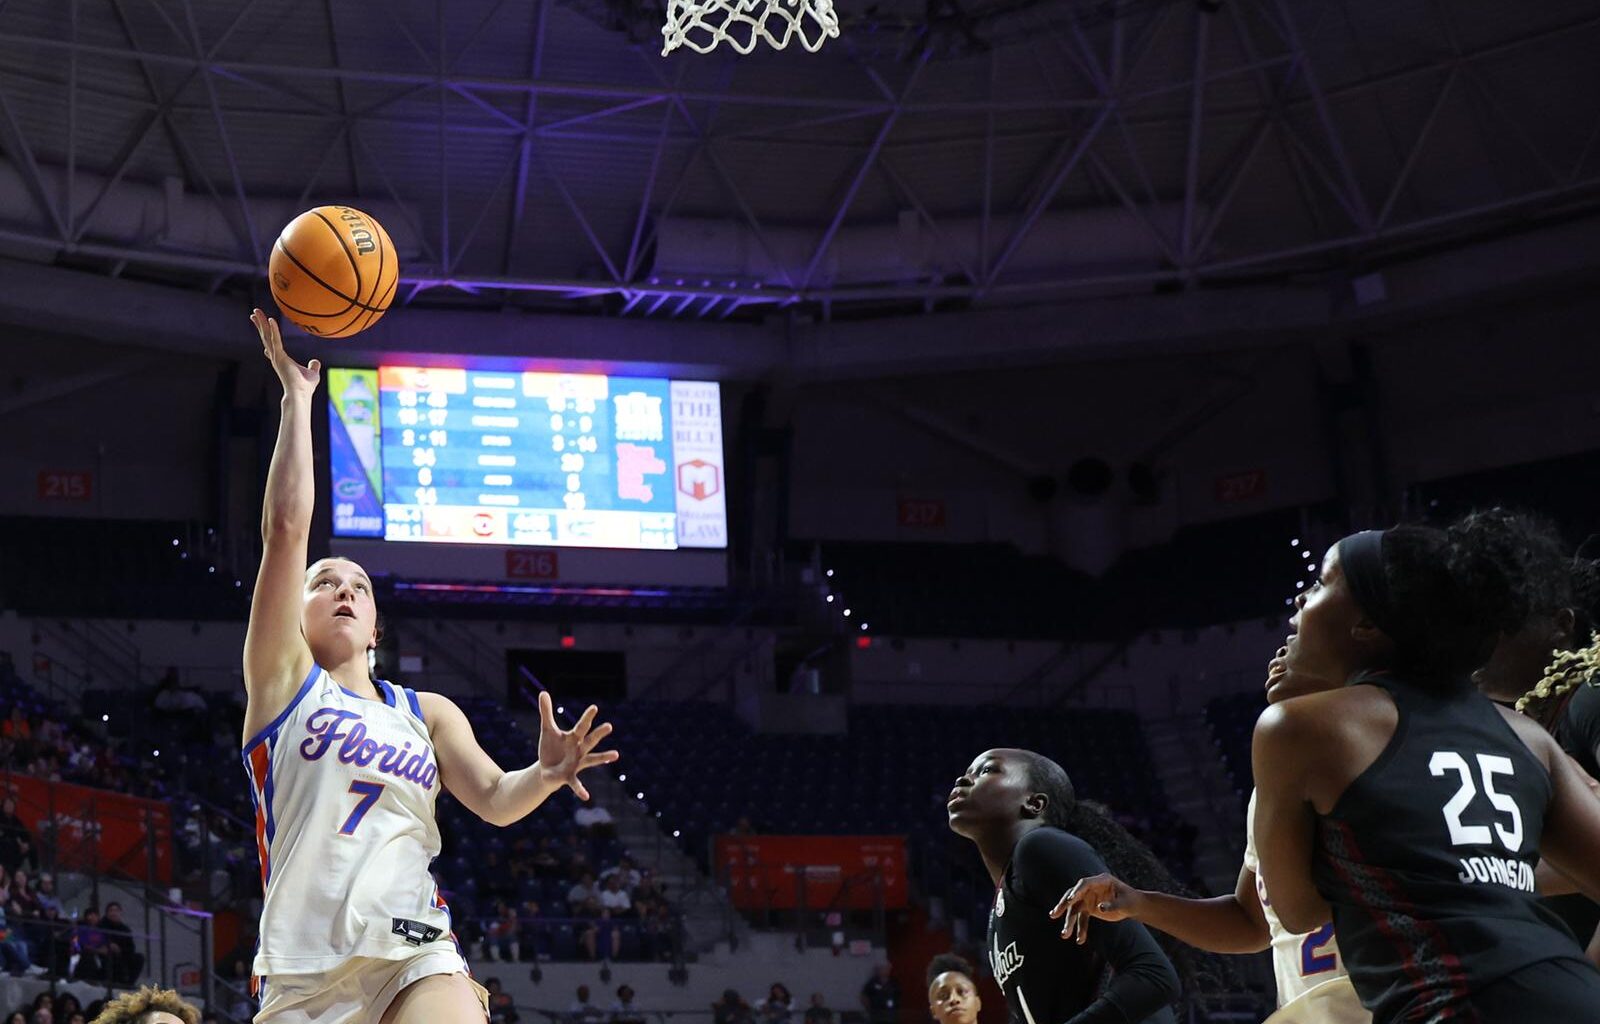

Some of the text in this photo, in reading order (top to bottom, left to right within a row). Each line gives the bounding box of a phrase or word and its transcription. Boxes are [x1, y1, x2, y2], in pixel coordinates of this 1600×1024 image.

[46, 475, 85, 496] 215
[905, 503, 938, 523] 217
[511, 554, 553, 574] 216
[299, 707, 437, 790] Florida
[338, 780, 386, 835] 7
[1428, 751, 1524, 852] 25
[1458, 856, 1535, 893] JOHNSON
